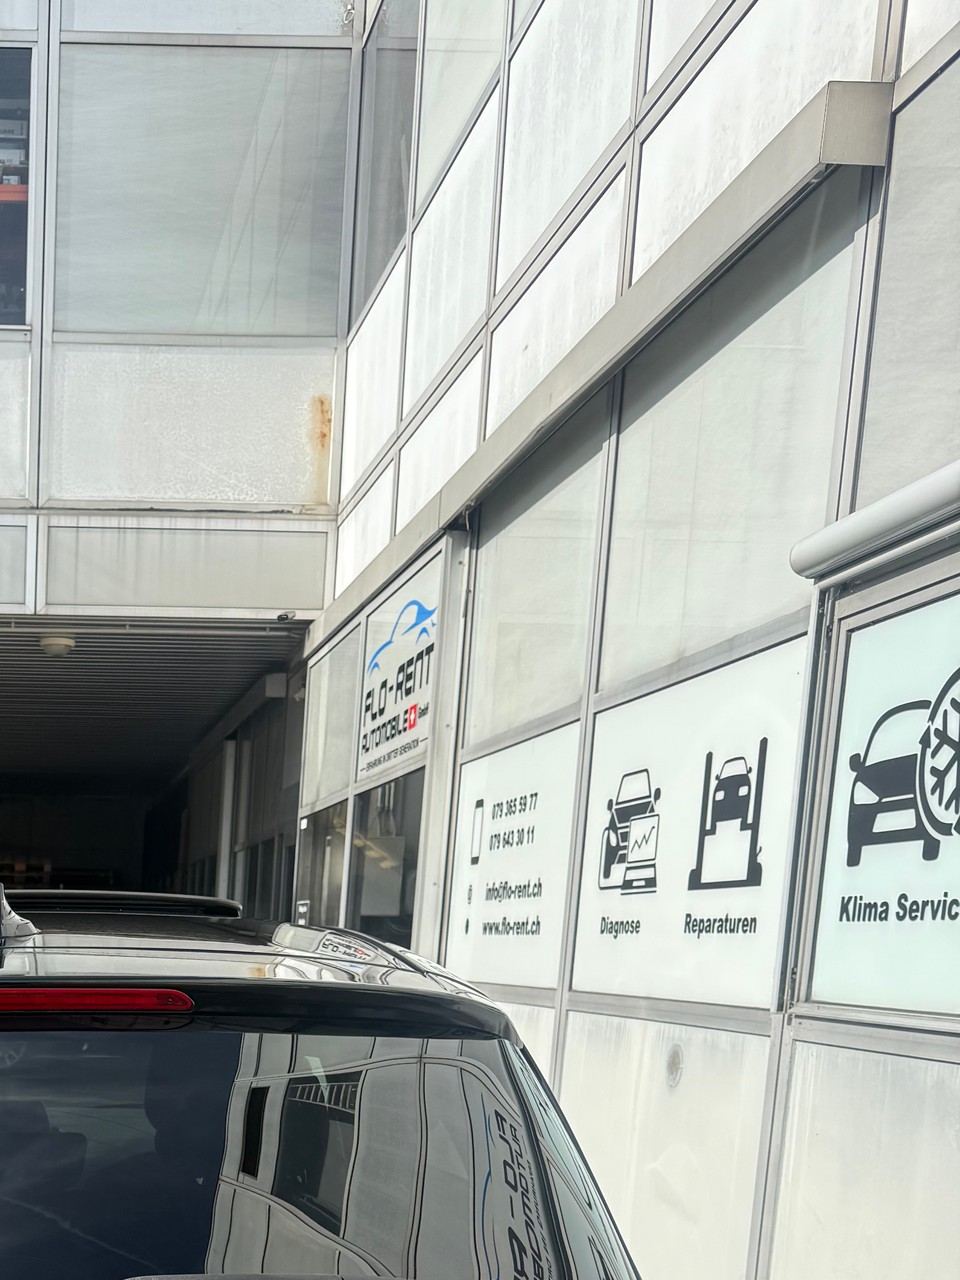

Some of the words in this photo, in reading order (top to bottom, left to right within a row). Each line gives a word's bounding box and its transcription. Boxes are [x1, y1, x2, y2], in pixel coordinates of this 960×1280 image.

[363, 642, 435, 728] FLO-RENT
[361, 708, 409, 756] AUTOMOBILE
[492, 801, 503, 820] 079
[518, 794, 527, 814] 59
[529, 792, 538, 811] 77
[489, 832, 501, 851] 079
[502, 830, 514, 849] 643
[516, 827, 525, 846] 30
[527, 825, 535, 844] 11
[485, 877, 542, 903] info@flo-rent.ch
[839, 895, 889, 922] Klima
[895, 891, 960, 921] Servic
[482, 915, 541, 935] www.flo-rent.ch
[600, 916, 641, 940] Diagnose
[684, 913, 758, 939] Reparaturen
